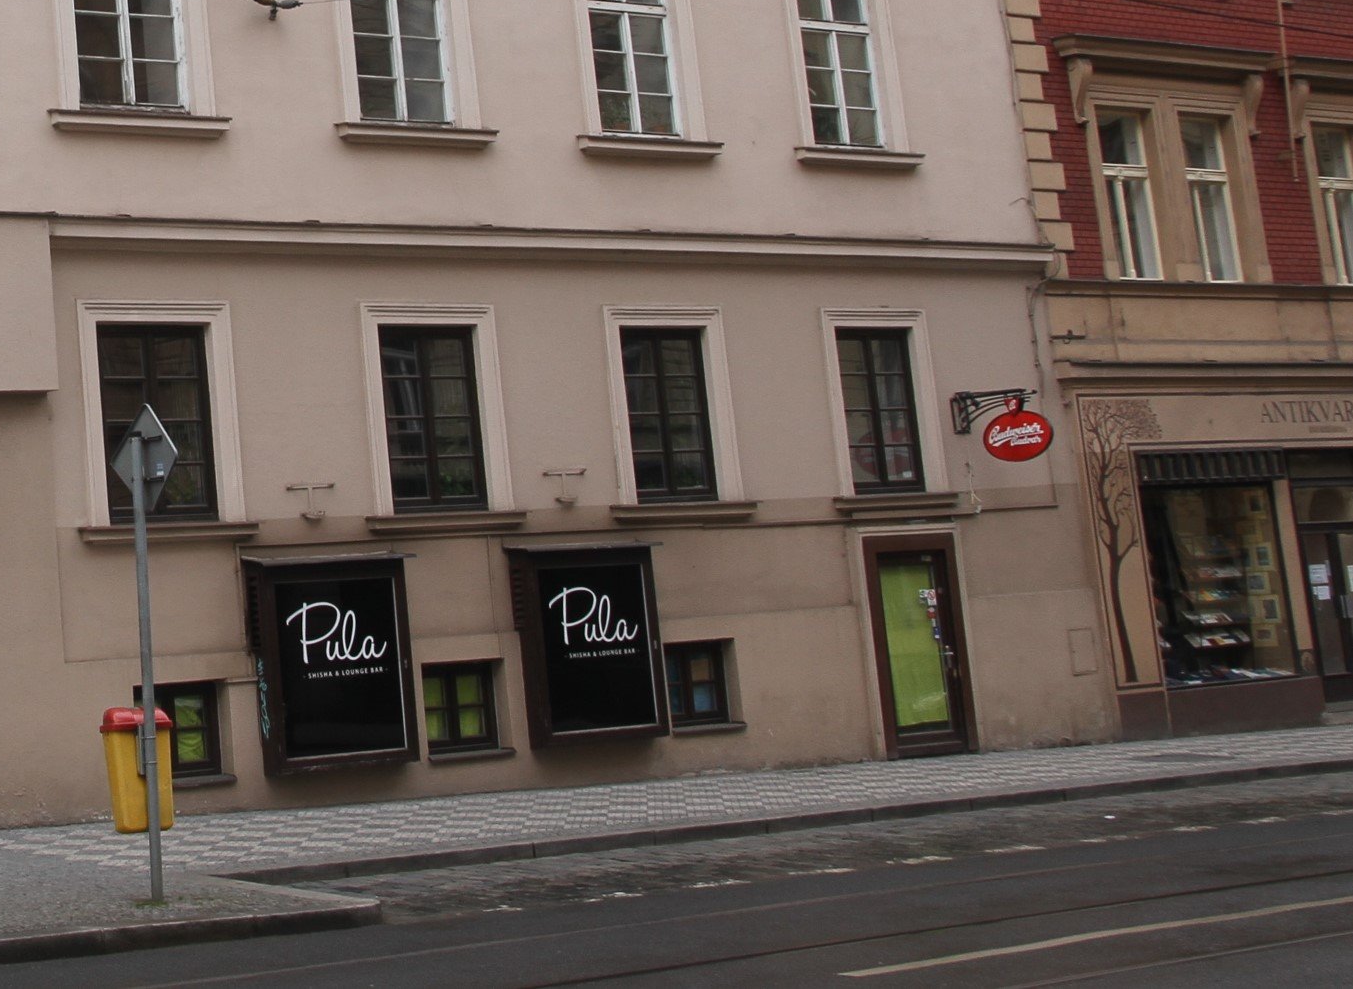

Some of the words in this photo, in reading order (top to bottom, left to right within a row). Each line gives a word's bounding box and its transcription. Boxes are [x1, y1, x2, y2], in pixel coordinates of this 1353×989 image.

[286, 601, 387, 664] Pula
[549, 586, 638, 645] Pula
[569, 651, 591, 659] SHISHA
[308, 671, 333, 679] SHISHA
[341, 668, 368, 676] LOUNGE
